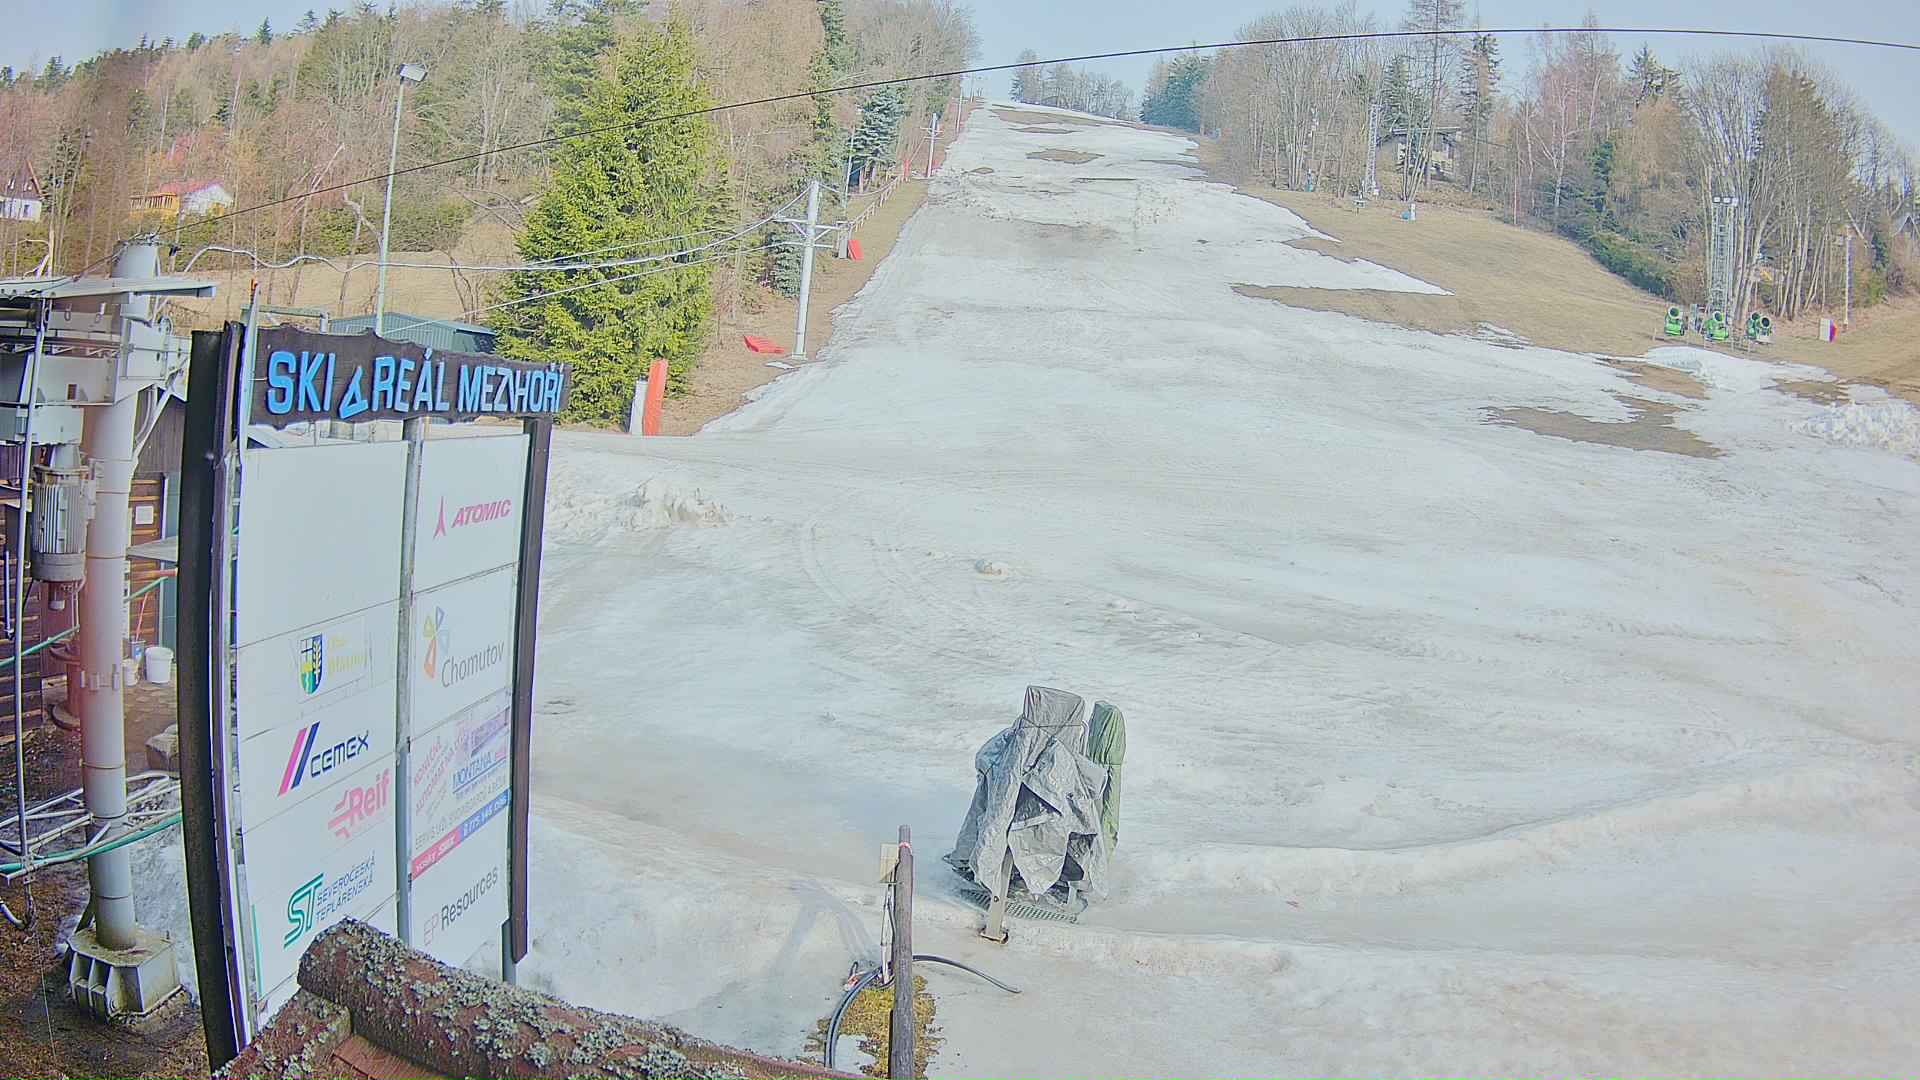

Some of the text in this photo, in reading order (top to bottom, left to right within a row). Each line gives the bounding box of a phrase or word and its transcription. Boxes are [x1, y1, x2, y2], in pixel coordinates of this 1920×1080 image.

[267, 350, 336, 414] SKI
[451, 499, 512, 529] ATOMIC
[441, 641, 505, 688] Chomutov
[310, 735, 370, 778] CEMEX
[351, 768, 390, 826] Reif
[284, 873, 324, 949] ST
[441, 866, 498, 931] Resources
